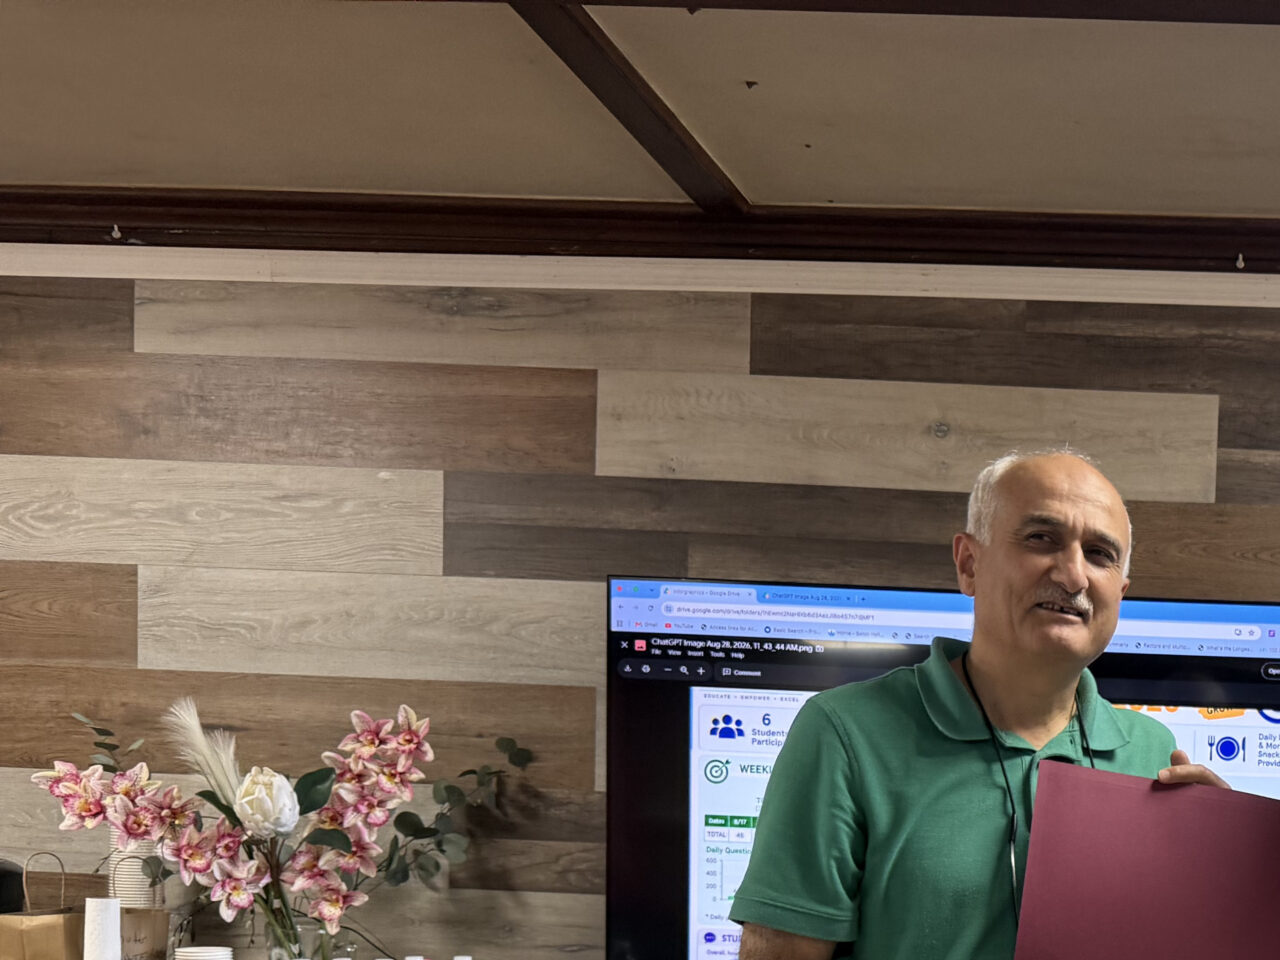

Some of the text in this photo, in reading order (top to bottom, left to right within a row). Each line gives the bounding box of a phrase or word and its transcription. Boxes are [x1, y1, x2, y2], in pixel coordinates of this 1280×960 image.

[651, 638, 682, 647] ChatGPT
[683, 639, 705, 648] Image
[706, 640, 721, 649] Aug
[753, 642, 785, 652] 11_43_44
[786, 645, 814, 654] AM.png
[710, 650, 726, 658] Tools
[733, 669, 762, 677] Comment
[762, 713, 771, 726] 6
[751, 738, 783, 747] Particip
[1258, 733, 1276, 743] Daily
[1257, 751, 1280, 759] Snack
[739, 764, 773, 774] WEEK
[706, 846, 751, 855] Daily Questi
